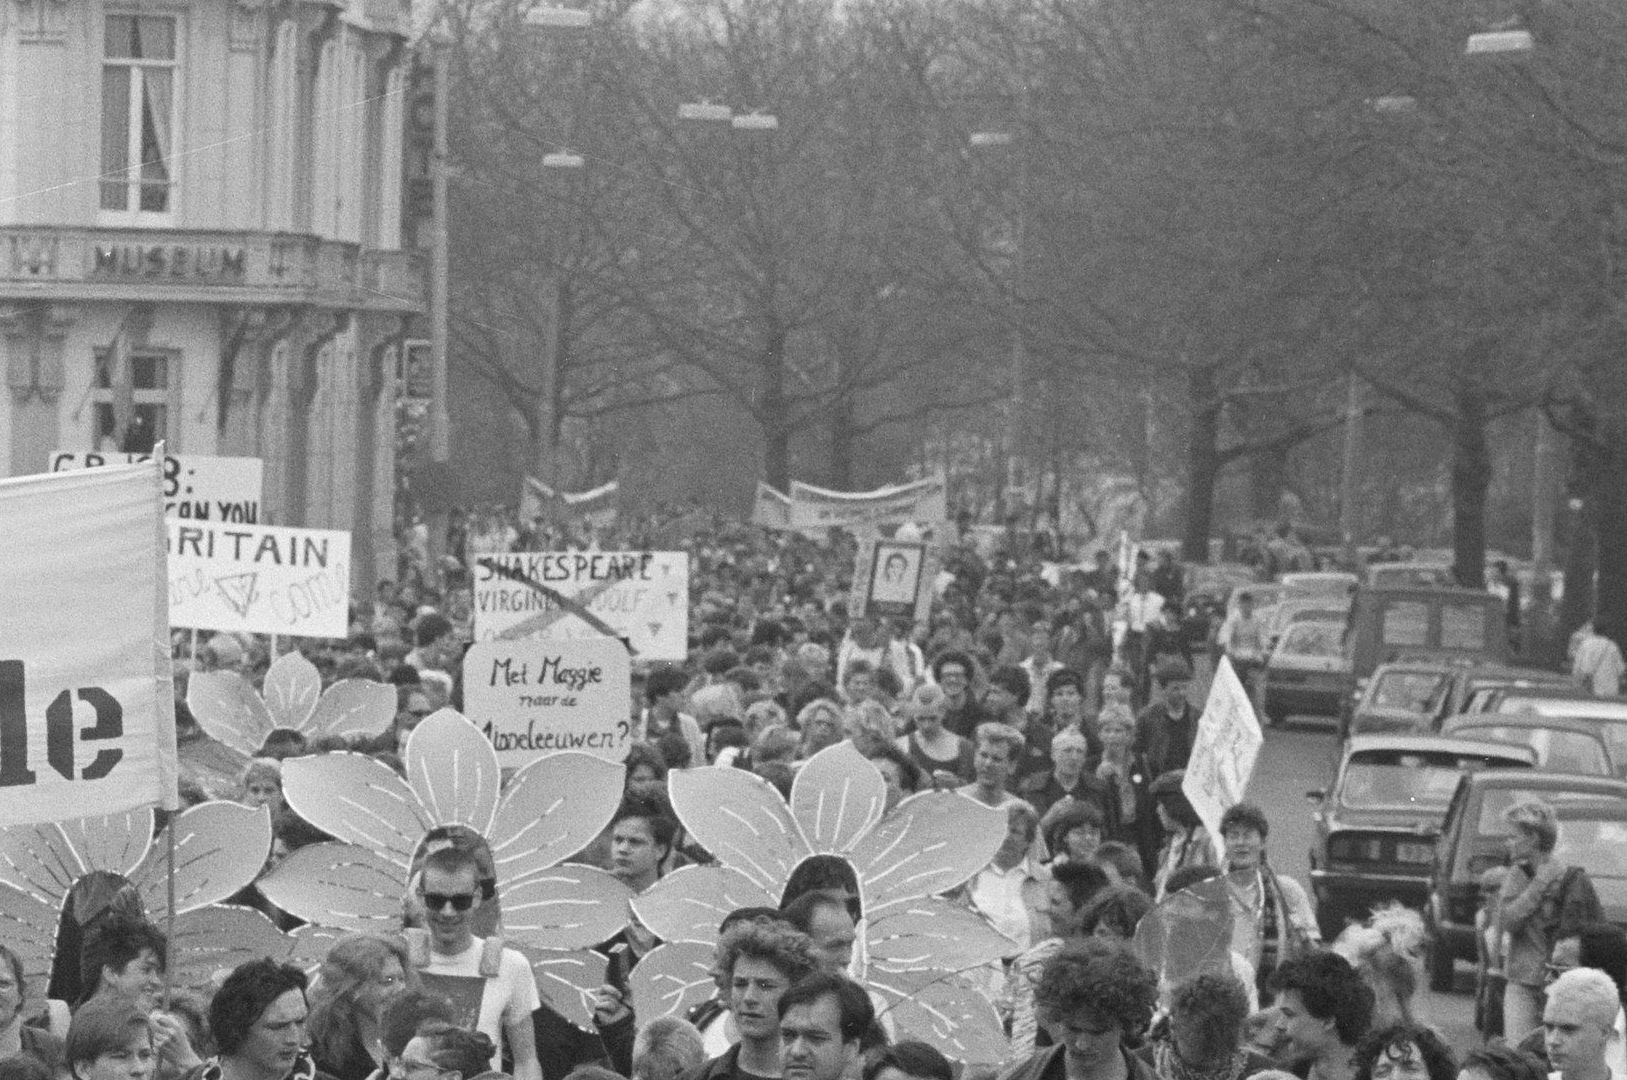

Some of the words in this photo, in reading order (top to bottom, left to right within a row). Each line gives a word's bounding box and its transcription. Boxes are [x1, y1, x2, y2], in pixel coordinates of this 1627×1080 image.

[94, 246, 247, 286] MUSEUM
[218, 501, 258, 524] YOU
[168, 527, 328, 568] RITAIN
[477, 554, 653, 581] SHAKESPEARE
[490, 658, 527, 687] Met
[537, 656, 602, 691] Maggie
[519, 695, 559, 707] naar
[560, 696, 577, 707] de
